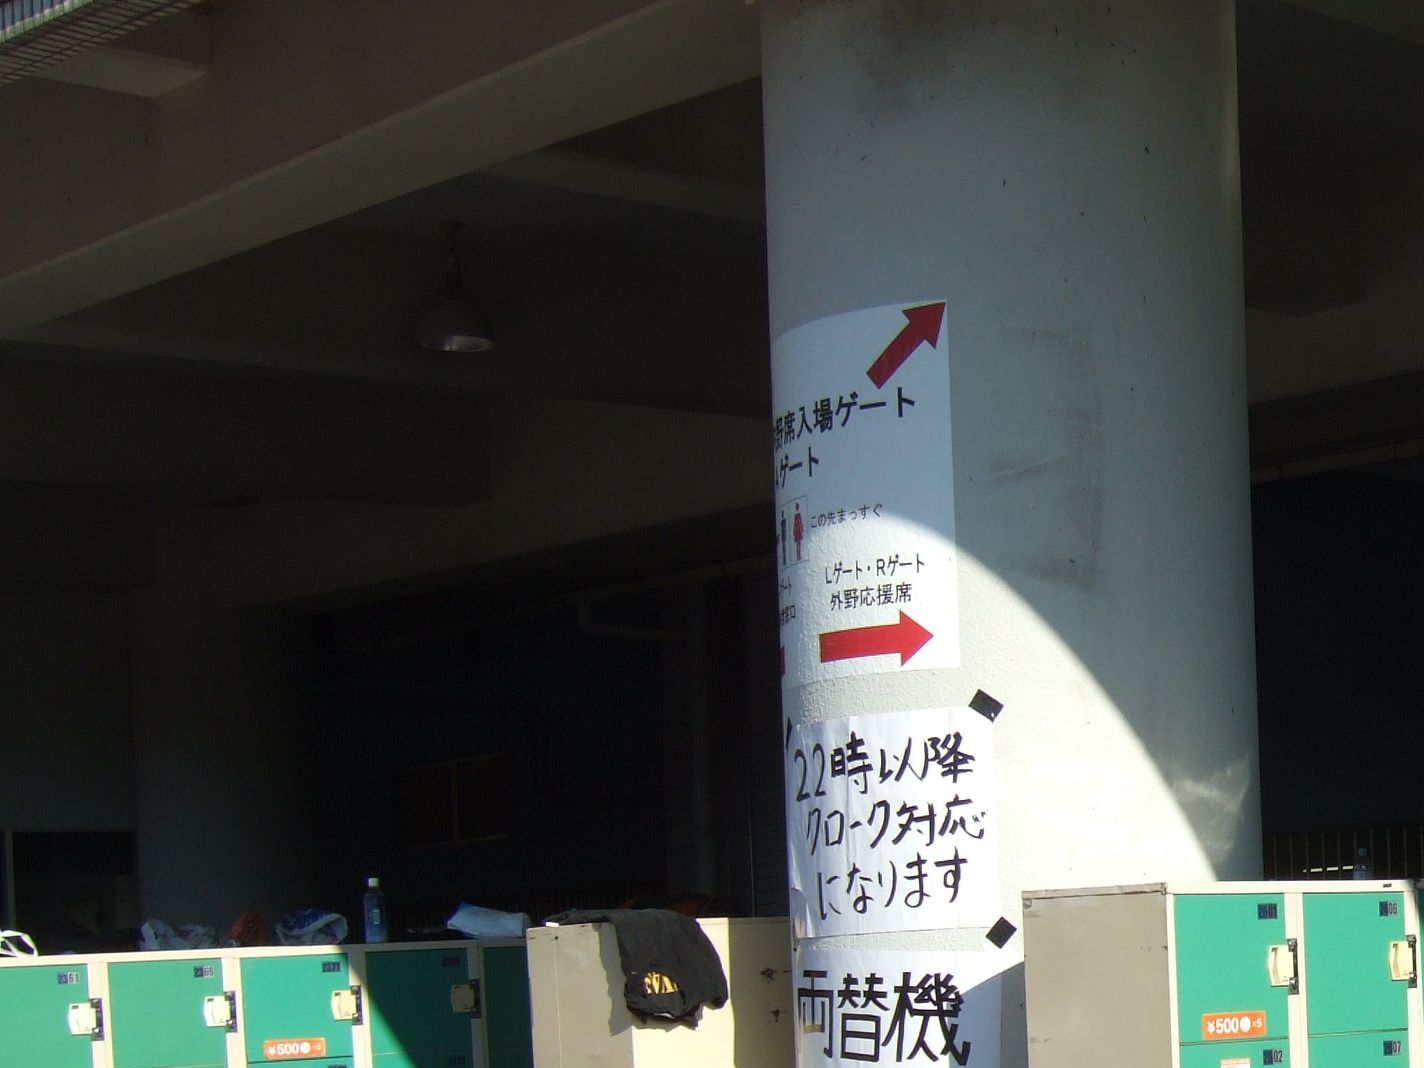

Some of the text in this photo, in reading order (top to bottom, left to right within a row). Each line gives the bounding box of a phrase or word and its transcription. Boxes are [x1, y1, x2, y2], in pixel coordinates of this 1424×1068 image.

[775, 446, 820, 489] ゲート
[810, 503, 884, 529] この先まっすぐ
[825, 553, 925, 585] Lゲート・Rゲート
[831, 582, 913, 612] 外野応援席
[794, 730, 976, 802] 22時以降
[806, 793, 989, 857] クローク対応
[817, 846, 968, 921] になります
[797, 969, 972, 1067] 両替機
[1207, 1016, 1239, 1034] ¥500
